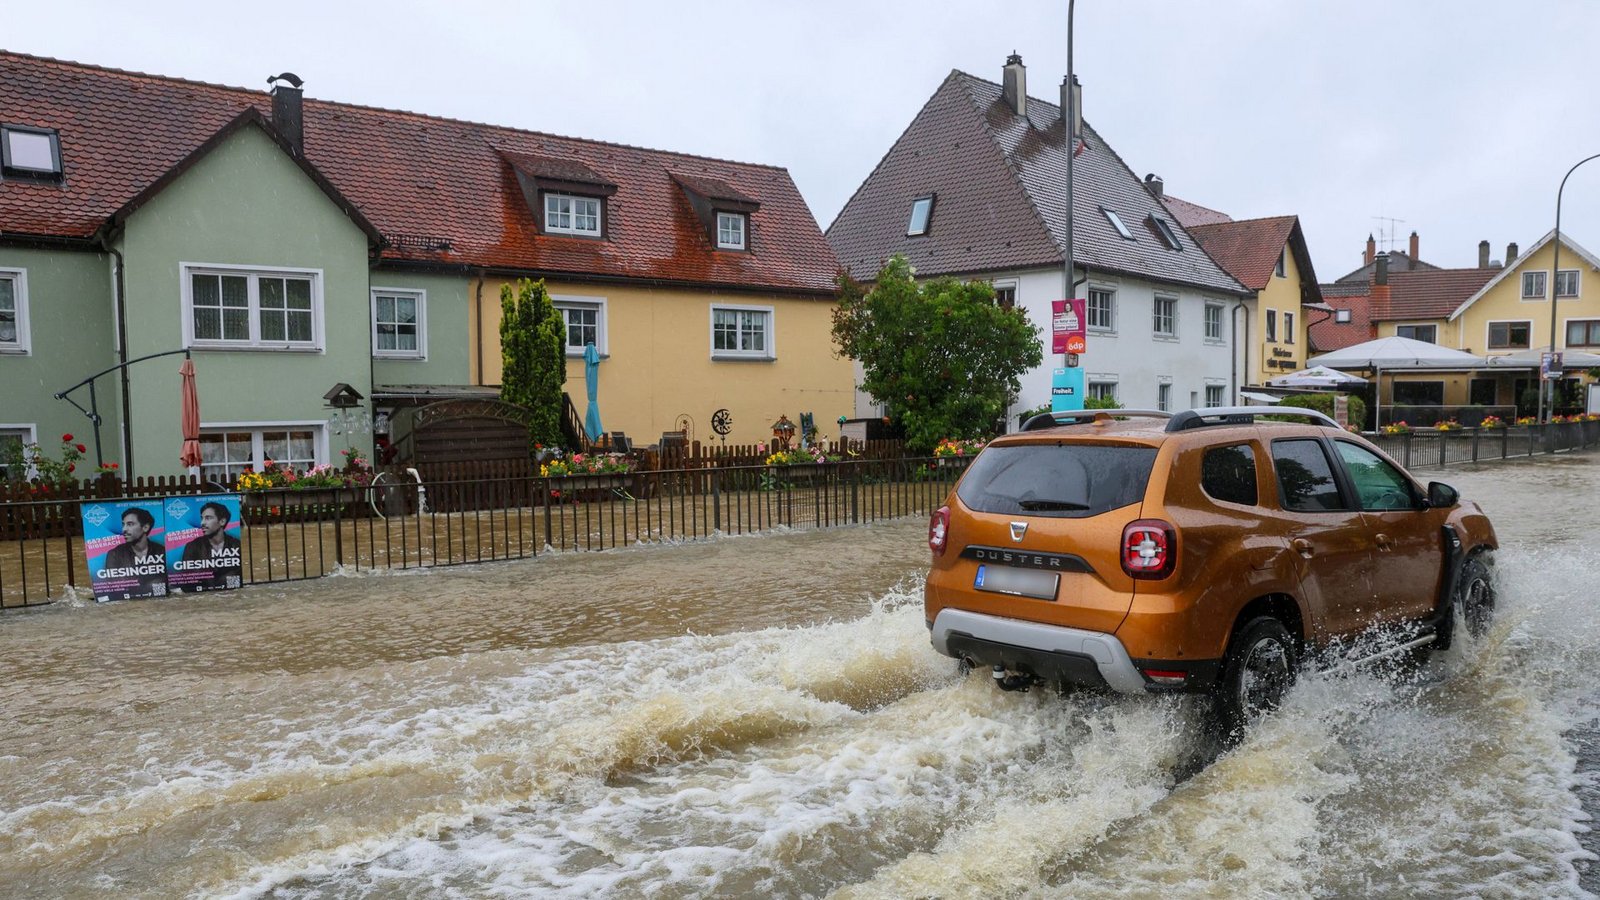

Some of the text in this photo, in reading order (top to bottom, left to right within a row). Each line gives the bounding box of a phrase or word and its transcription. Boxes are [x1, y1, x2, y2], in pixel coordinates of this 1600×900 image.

[134, 553, 164, 565] MAX
[211, 547, 239, 558] MAX
[976, 550, 1061, 567] DUSTER
[173, 557, 240, 571] GIESINGER
[96, 565, 165, 579] GIESINGER
